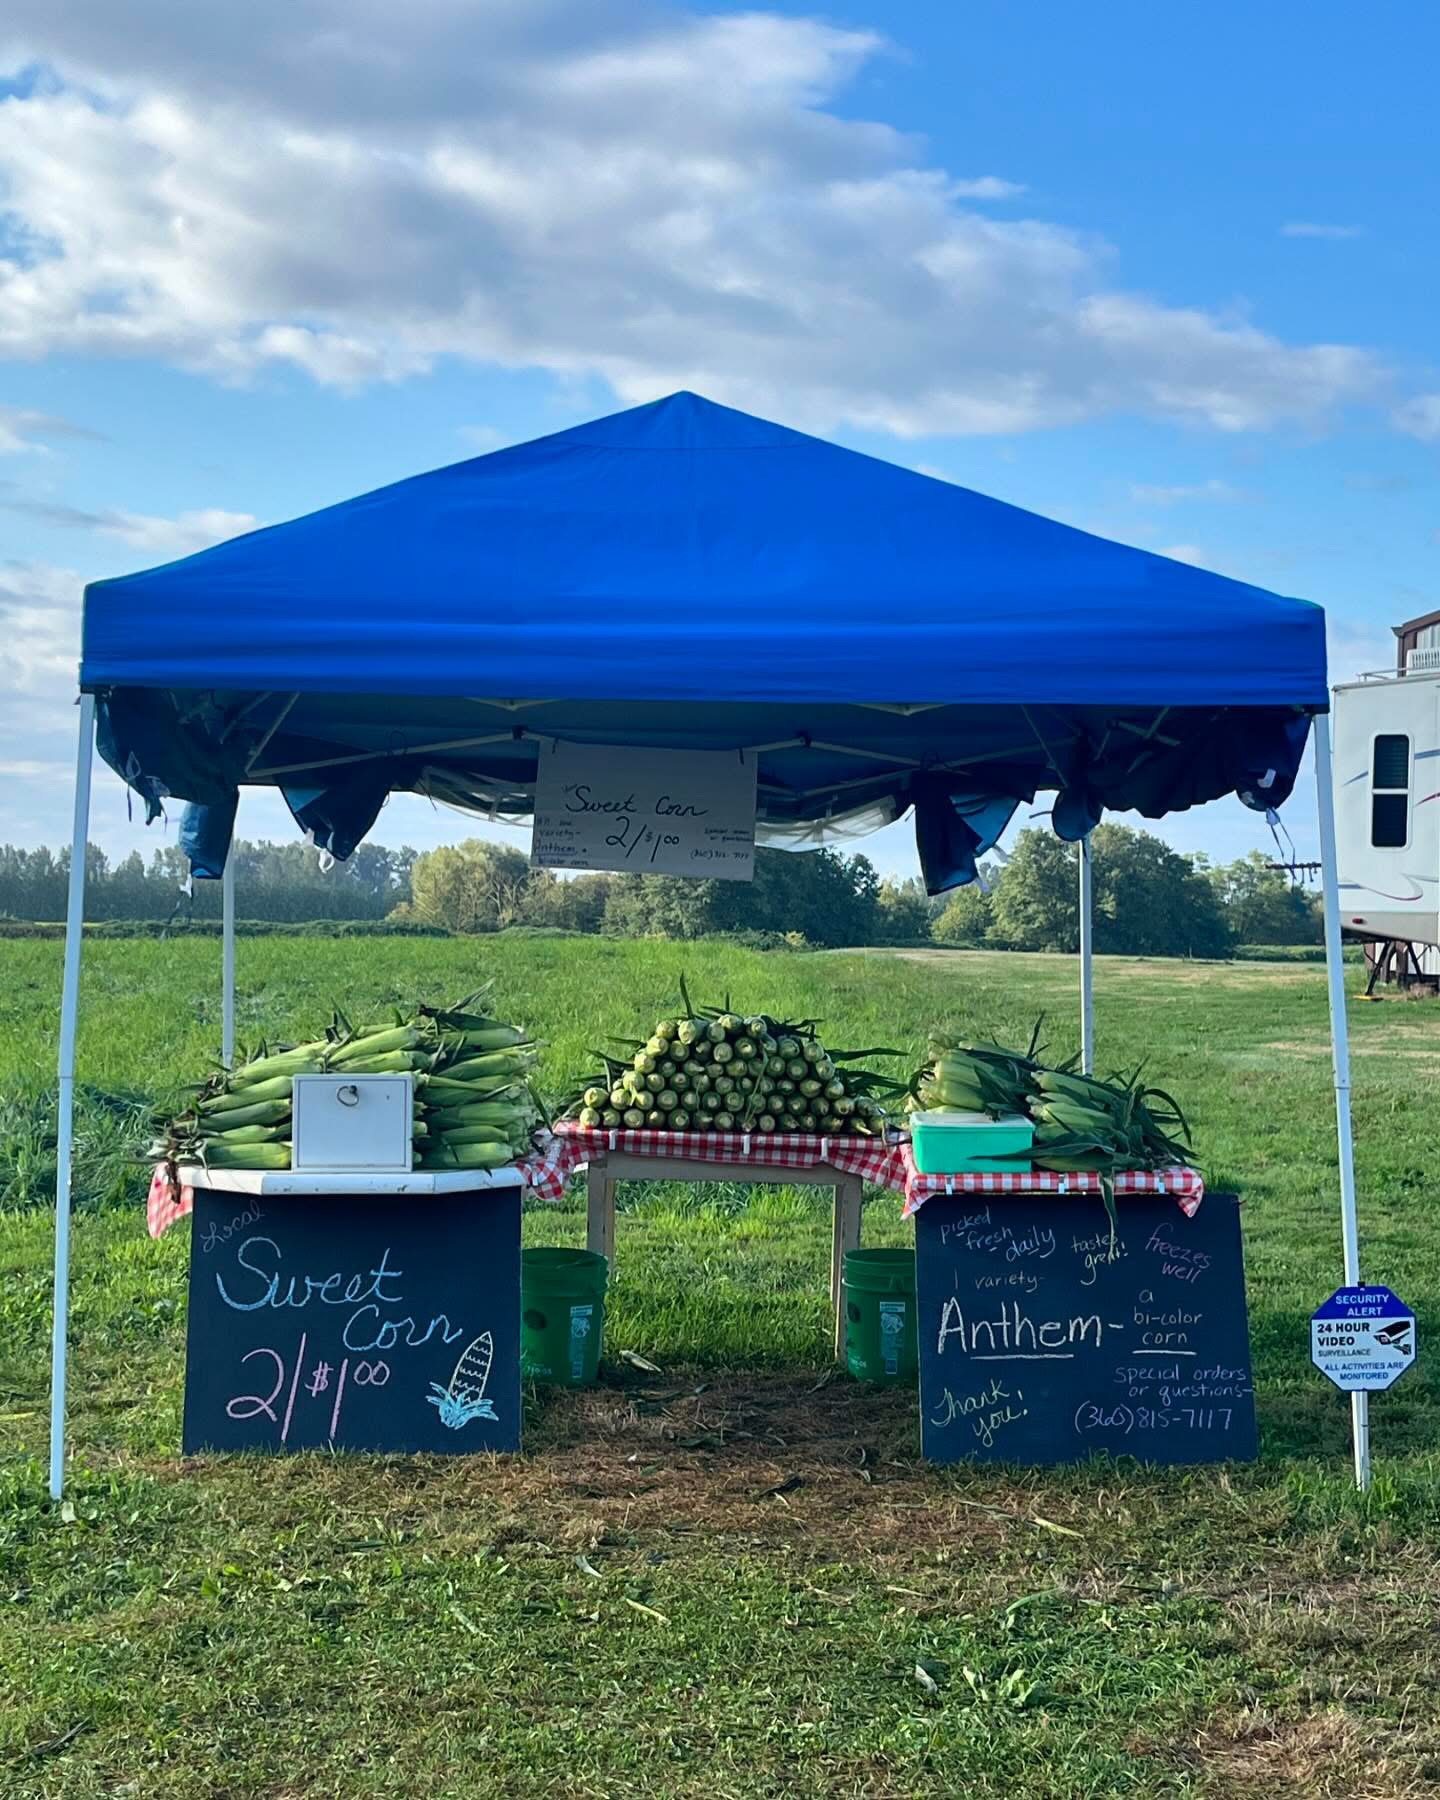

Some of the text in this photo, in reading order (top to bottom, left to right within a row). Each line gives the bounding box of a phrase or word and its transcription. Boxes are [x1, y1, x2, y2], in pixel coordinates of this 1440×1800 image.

[565, 785, 709, 816] Sweet Corn
[200, 1201, 266, 1252] Local
[940, 1206, 991, 1245] picked
[965, 1228, 1013, 1251] fresh
[1006, 1229, 1056, 1263] daily
[1145, 1222, 1212, 1269] freezes
[216, 1236, 403, 1311] Sweet
[1162, 1261, 1201, 1284] well
[1139, 1289, 1154, 1304] a
[1335, 1294, 1390, 1305] SECURITY
[1133, 1307, 1203, 1325] bi-color
[1346, 1306, 1383, 1316] ALERT
[342, 1304, 463, 1351] Corn
[1317, 1322, 1370, 1333] 24 HOUR
[1142, 1330, 1188, 1346] corn
[1317, 1336, 1355, 1346] VIDEO
[1317, 1348, 1371, 1357] SURVEILLANCE
[1192, 1364, 1248, 1381] orders
[1324, 1361, 1404, 1371] ALL ACTIVITIES ARE
[1340, 1372, 1389, 1380] MONITORED
[1128, 1386, 1150, 1397] or
[931, 1379, 1010, 1427] Thank
